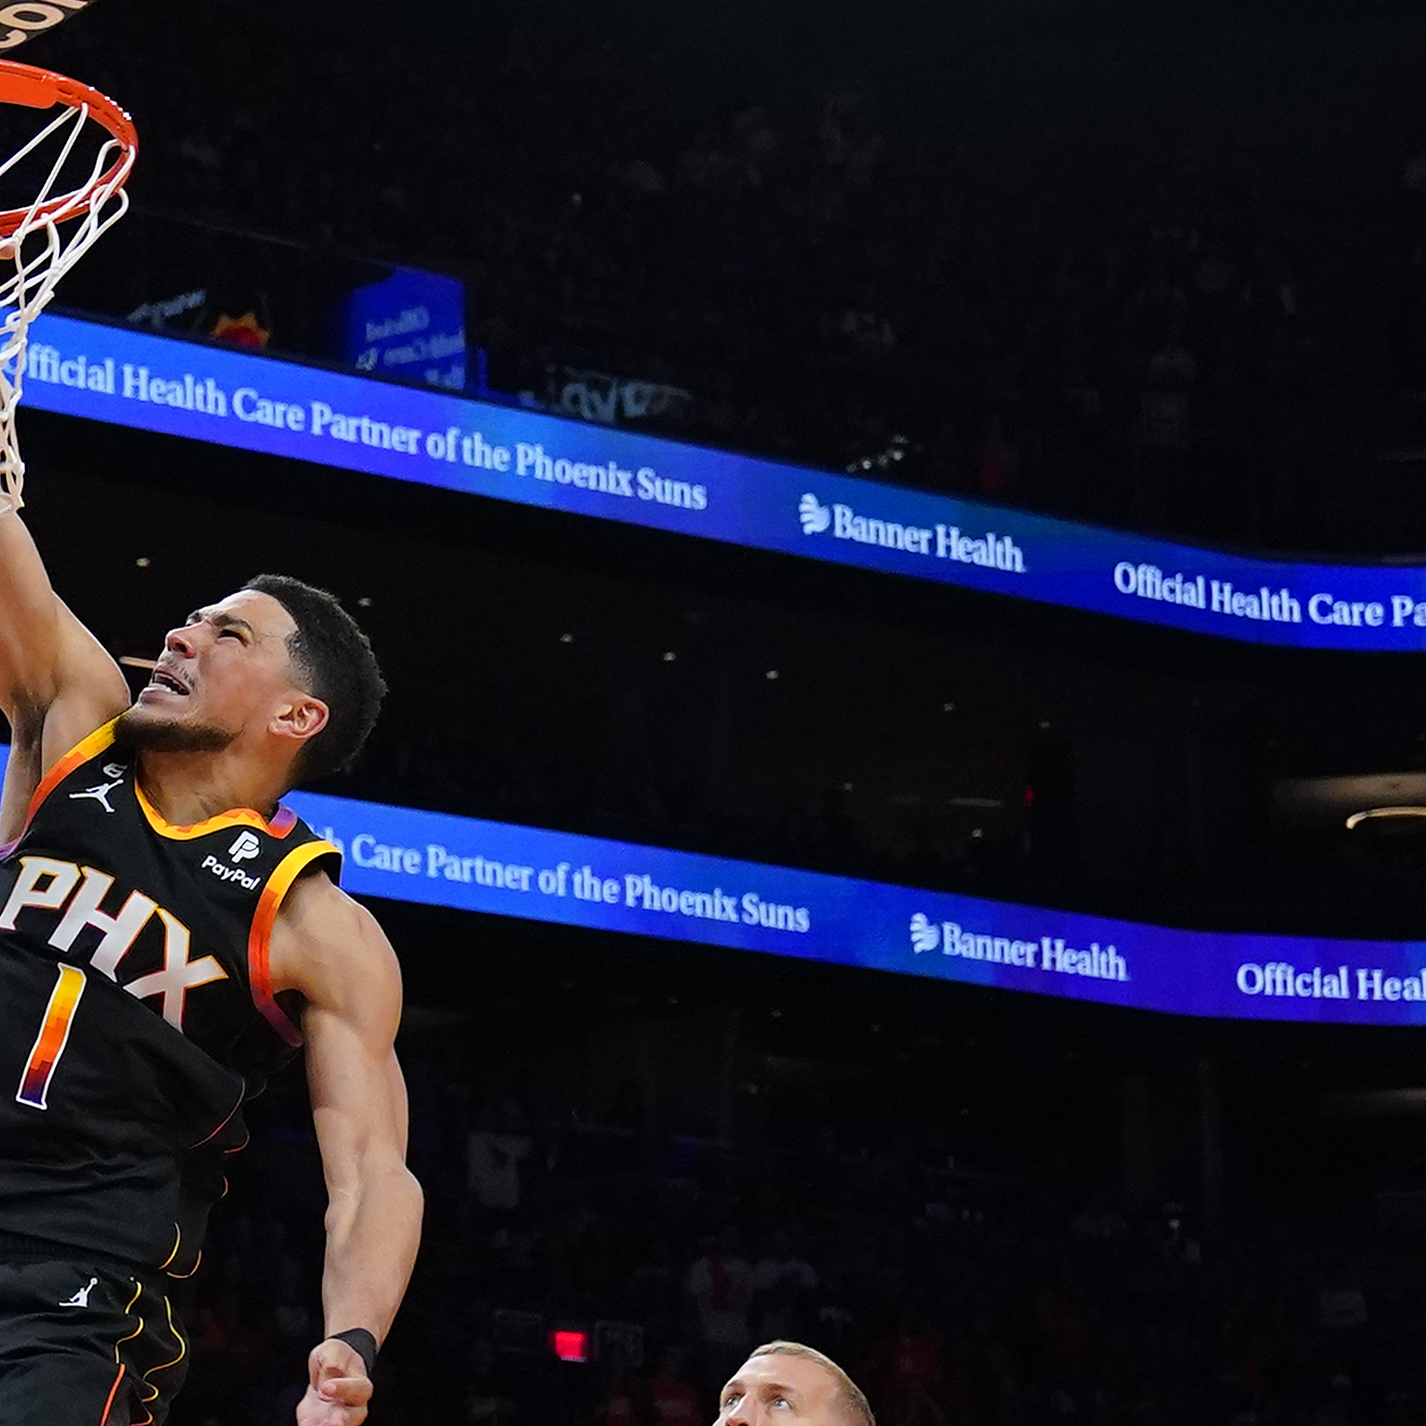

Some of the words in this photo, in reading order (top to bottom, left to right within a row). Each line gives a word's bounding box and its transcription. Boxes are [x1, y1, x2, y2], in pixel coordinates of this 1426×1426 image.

[122, 365, 227, 419] Health
[231, 387, 305, 433] Care
[310, 402, 422, 457] Partner
[426, 427, 461, 463] of
[463, 432, 512, 474] the
[515, 443, 634, 499] Phoenix
[636, 466, 708, 512] Suns
[833, 505, 931, 557] Banner
[935, 524, 1027, 573] Health
[1114, 561, 1206, 610] Official
[1211, 580, 1301, 624] Health
[1308, 593, 1384, 627] Care
[202, 854, 262, 892] PayPal
[351, 834, 420, 877] Care
[426, 847, 532, 894] Partner
[538, 862, 569, 896] of
[572, 868, 620, 905] the
[625, 876, 738, 924] Phoenix
[742, 895, 810, 934] Suns
[942, 922, 1038, 967] Banner
[1042, 937, 1128, 981] Health
[1236, 962, 1350, 999] Official
[16, 961, 88, 1110] 1
